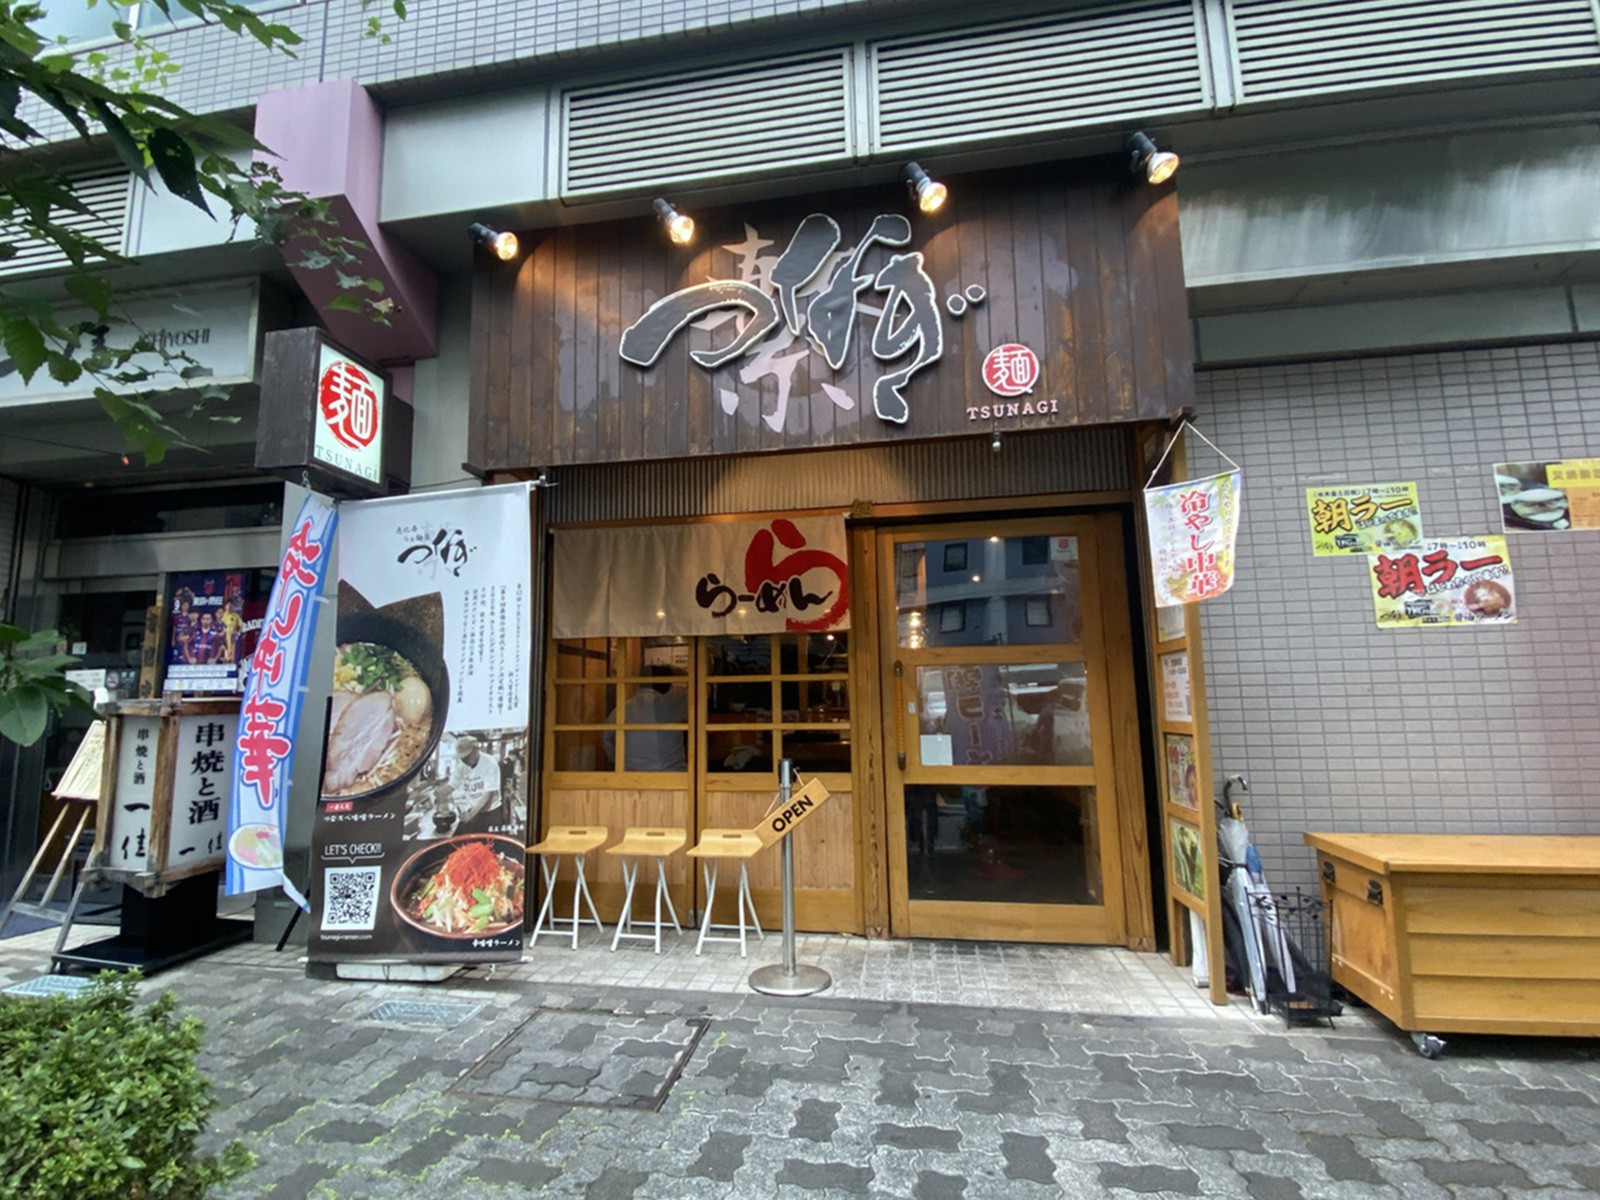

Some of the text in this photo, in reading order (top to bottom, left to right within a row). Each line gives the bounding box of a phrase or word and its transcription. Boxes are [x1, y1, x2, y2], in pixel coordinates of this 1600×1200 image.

[966, 400, 1059, 420] TSUNAGI
[315, 445, 378, 481] TSUNAGI
[1311, 494, 1413, 534] 朝ラー
[1179, 491, 1219, 595] 冷やし中華
[695, 573, 833, 618] らーめん
[1373, 549, 1503, 600] 朝ラー
[133, 728, 150, 785] 串焼と酒
[190, 723, 225, 825] 串焼と酒
[121, 802, 151, 860] 一佳
[772, 794, 814, 832] OPEN
[325, 844, 347, 856] LET'S
